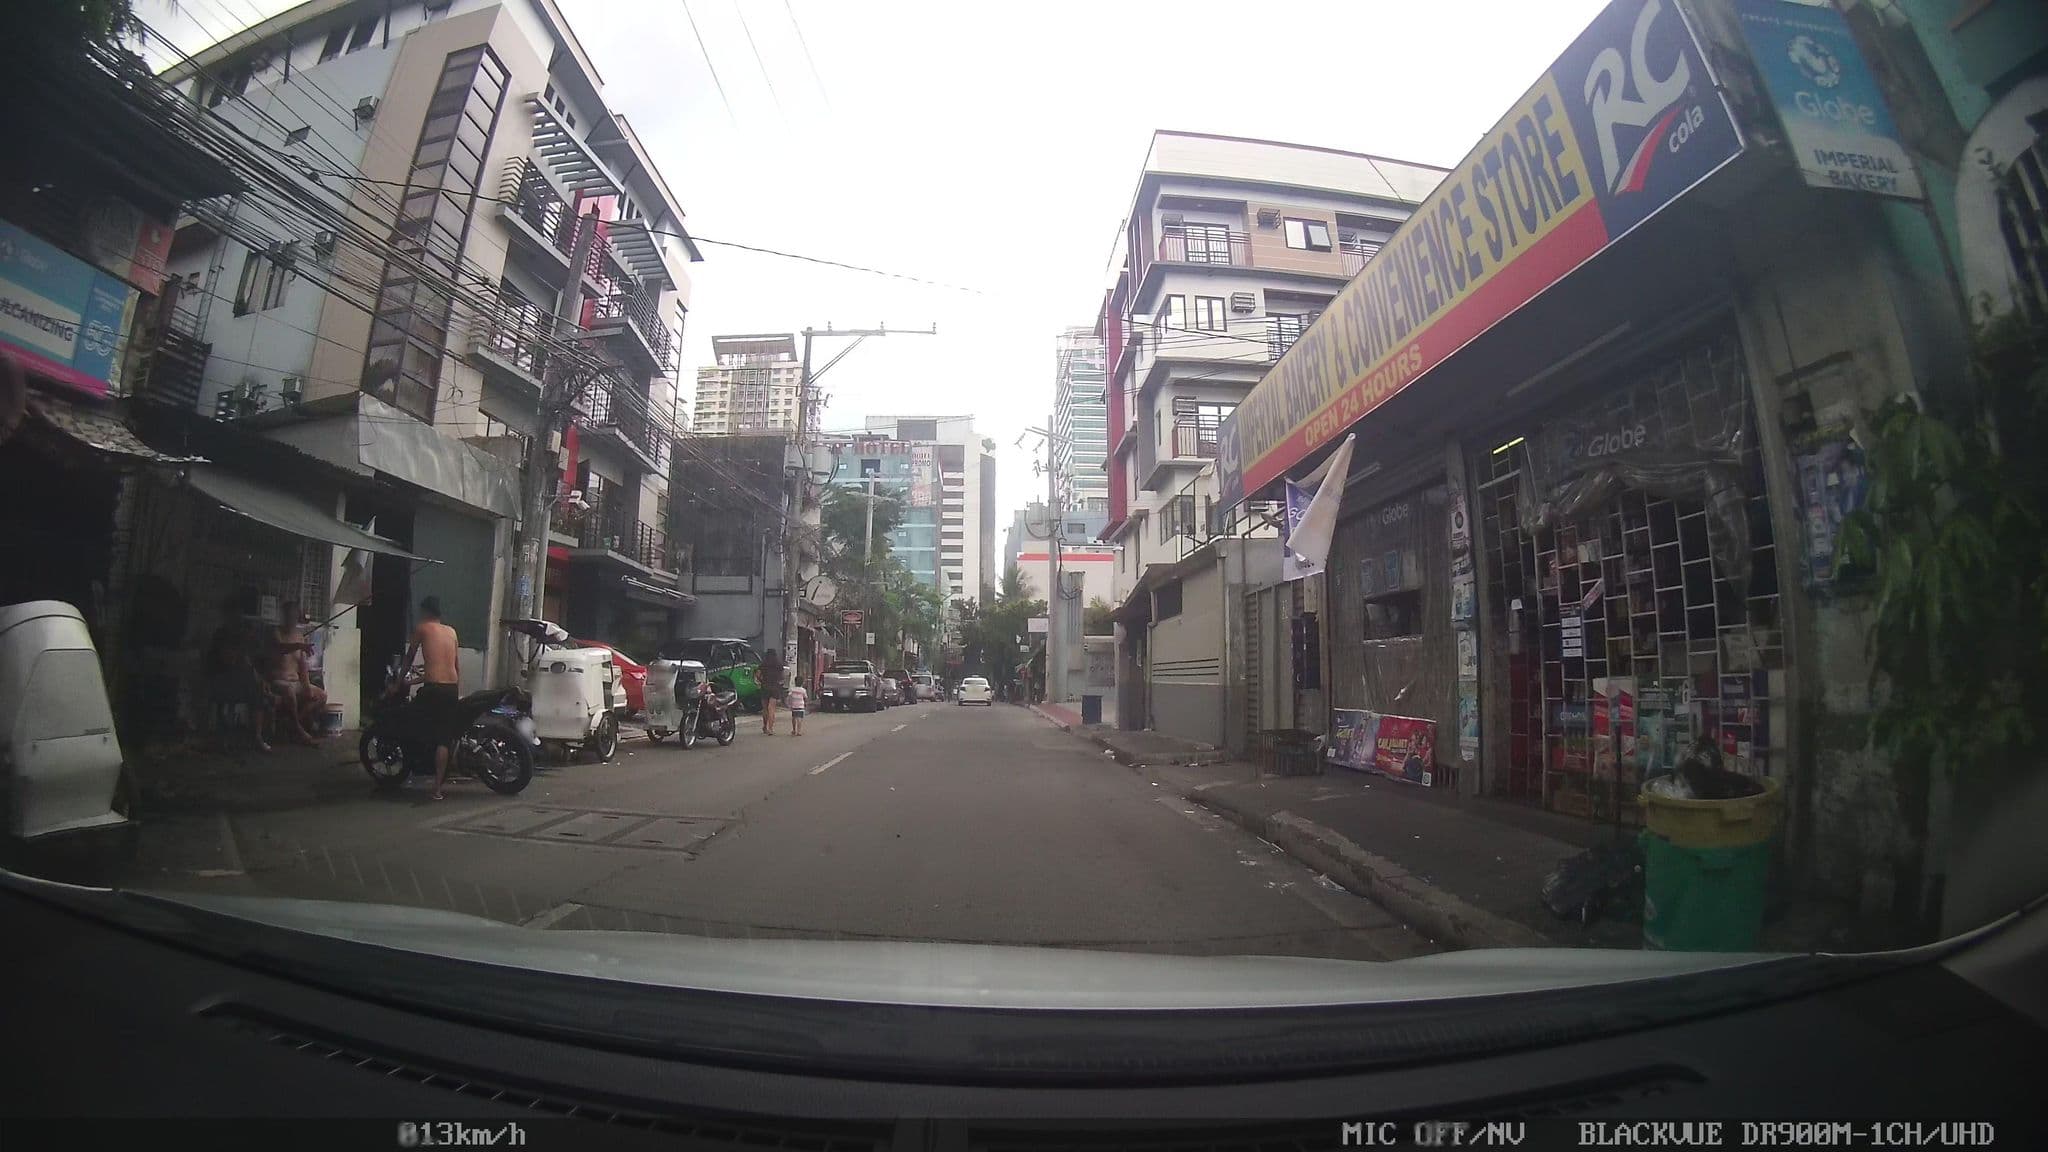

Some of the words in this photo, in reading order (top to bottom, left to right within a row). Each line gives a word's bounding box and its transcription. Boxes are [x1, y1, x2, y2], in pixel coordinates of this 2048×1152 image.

[1584, 0, 1690, 195] RC
[1795, 91, 1875, 125] Globe
[1669, 105, 1704, 152] cola
[1814, 149, 1898, 173] IMPERIAL
[1829, 169, 1896, 191] BAKERY
[1239, 375, 1285, 466] IMPERIAL
[1282, 323, 1332, 431] BAKERY
[1331, 313, 1347, 388] &
[1344, 181, 1483, 376] CONVENIENCE
[1472, 94, 1581, 262] STORE
[1305, 409, 1339, 446] OPEN
[1341, 394, 1359, 421] 24
[1362, 344, 1423, 407] HOURS
[1588, 424, 1646, 457] Globe
[1382, 503, 1409, 525] Globe
